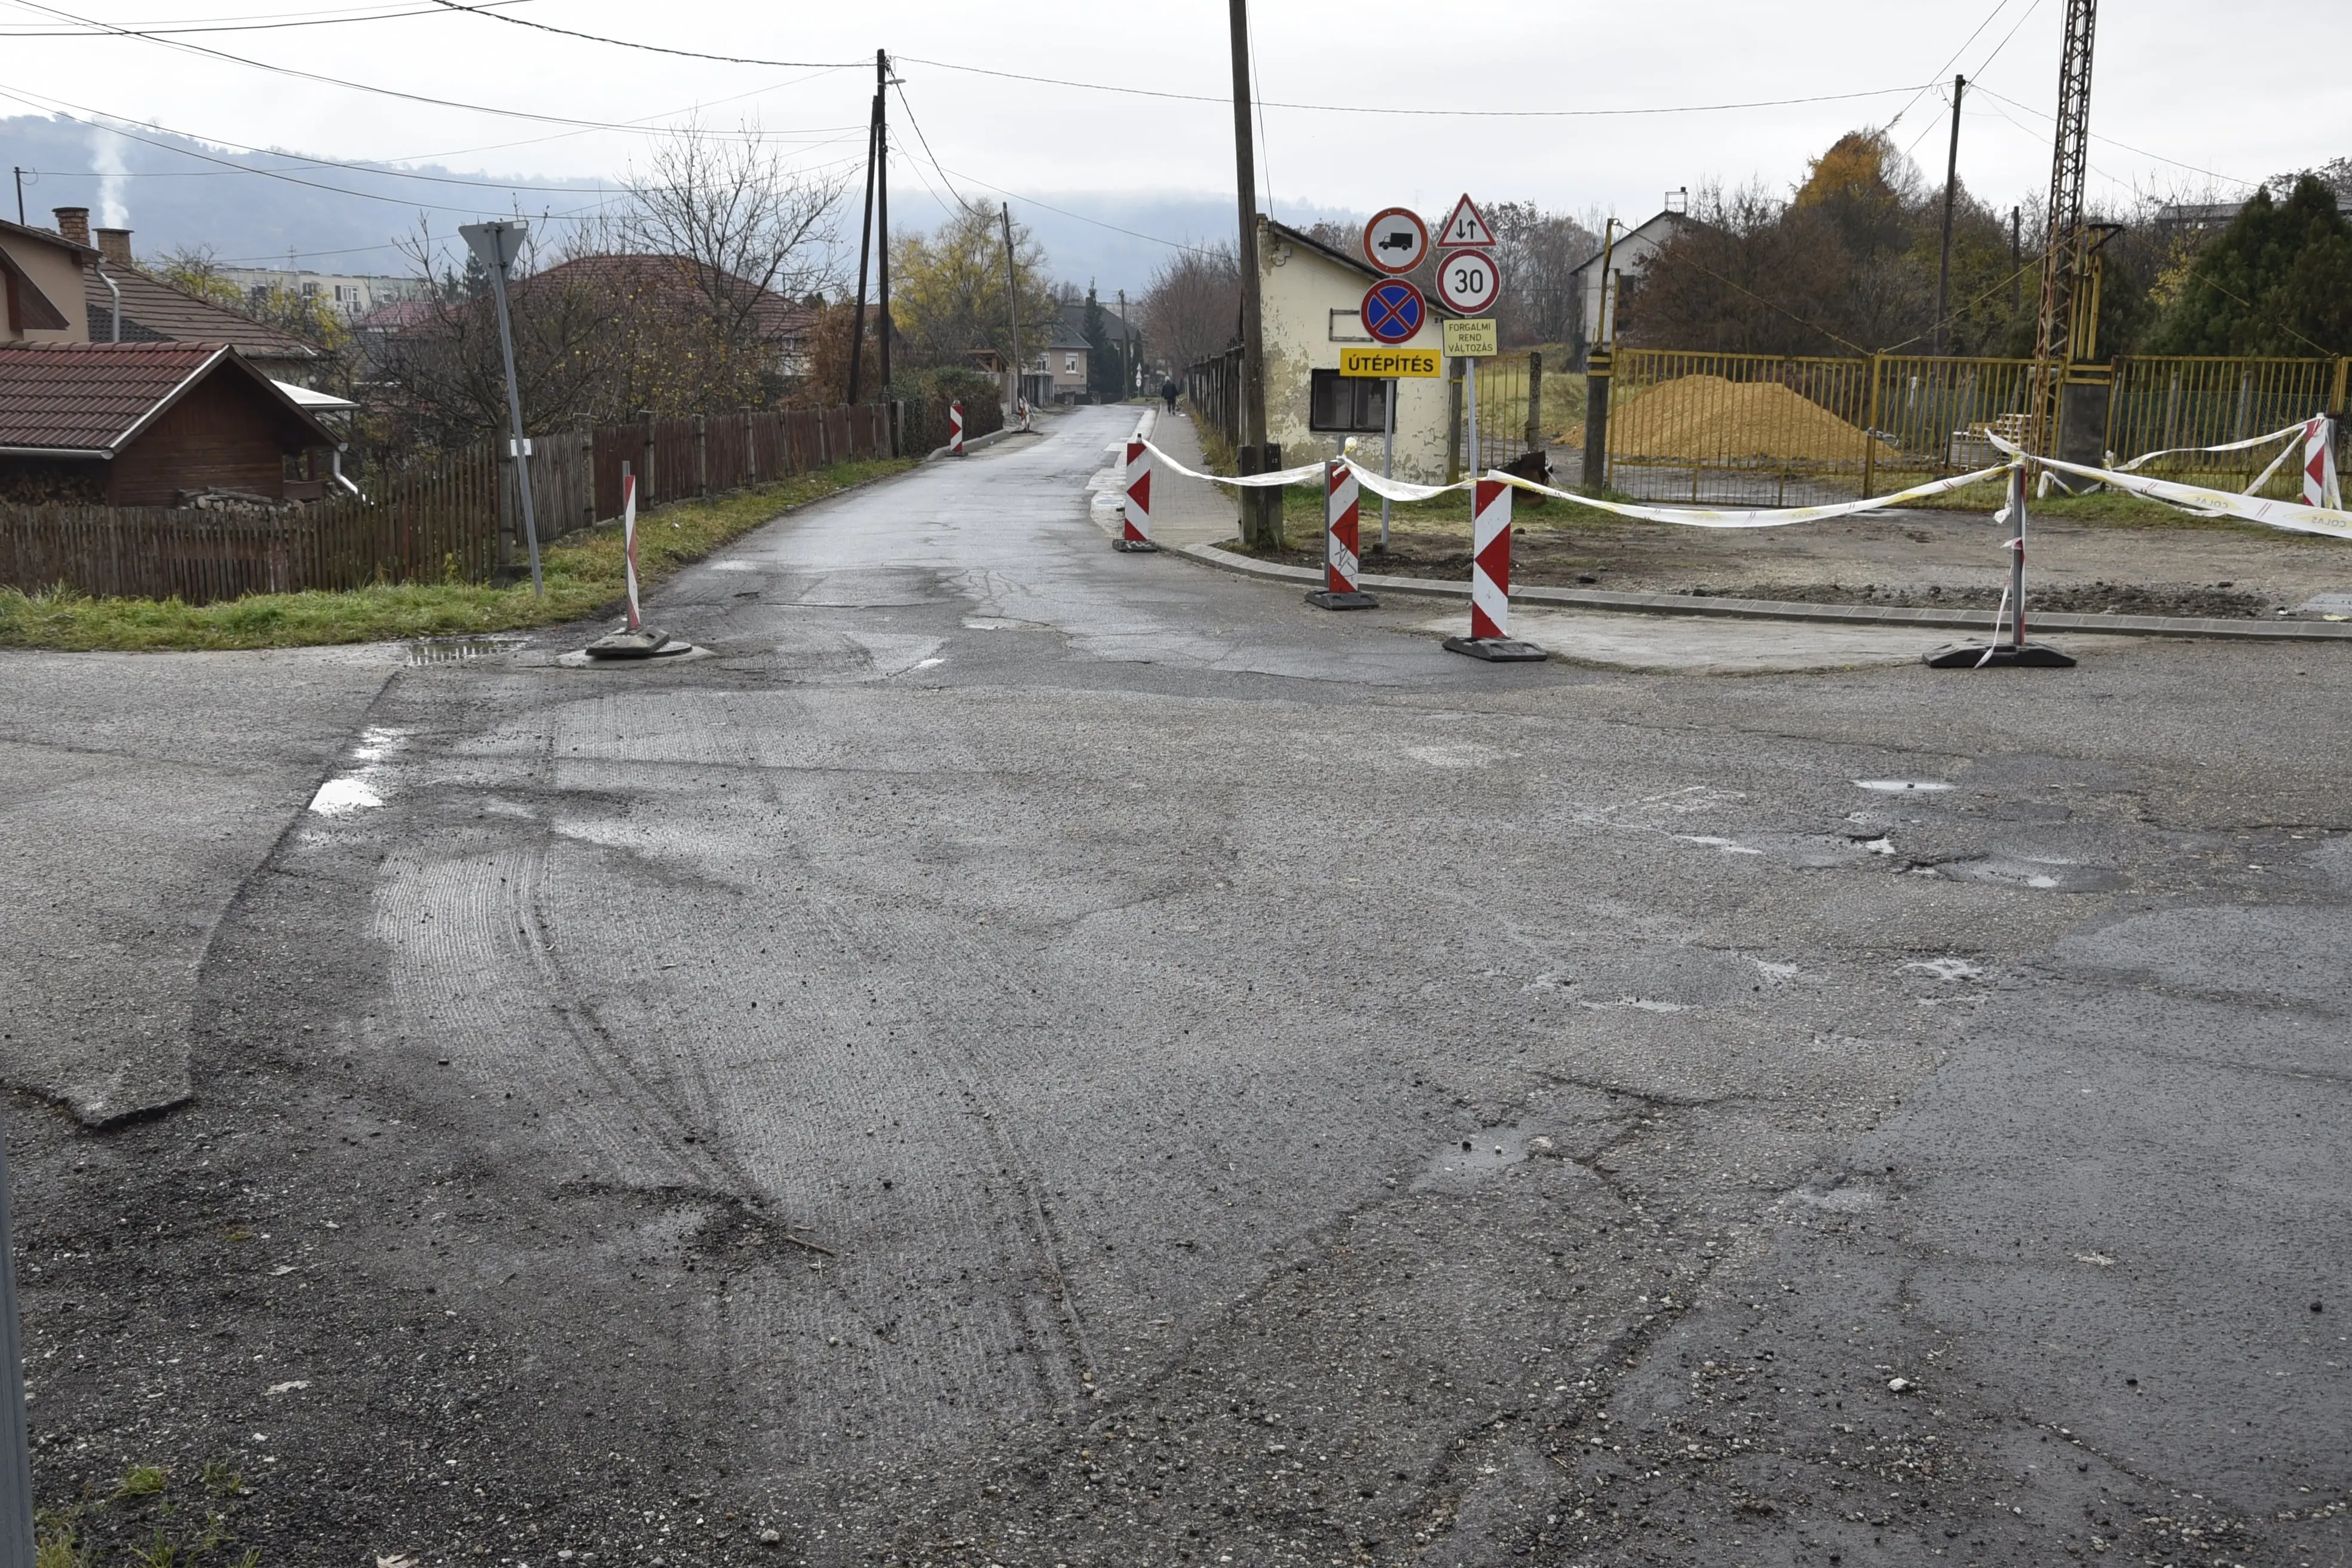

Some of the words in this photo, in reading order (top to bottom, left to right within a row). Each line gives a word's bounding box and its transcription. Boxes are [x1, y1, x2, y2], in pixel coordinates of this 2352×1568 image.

[1454, 269, 1483, 293] 30
[1448, 323, 1491, 332] FORGALMI
[1459, 333, 1482, 342] REND
[1448, 342, 1493, 353] VÁLTOZÁS
[1349, 354, 1434, 372] ÚTÉPÍTÉS
